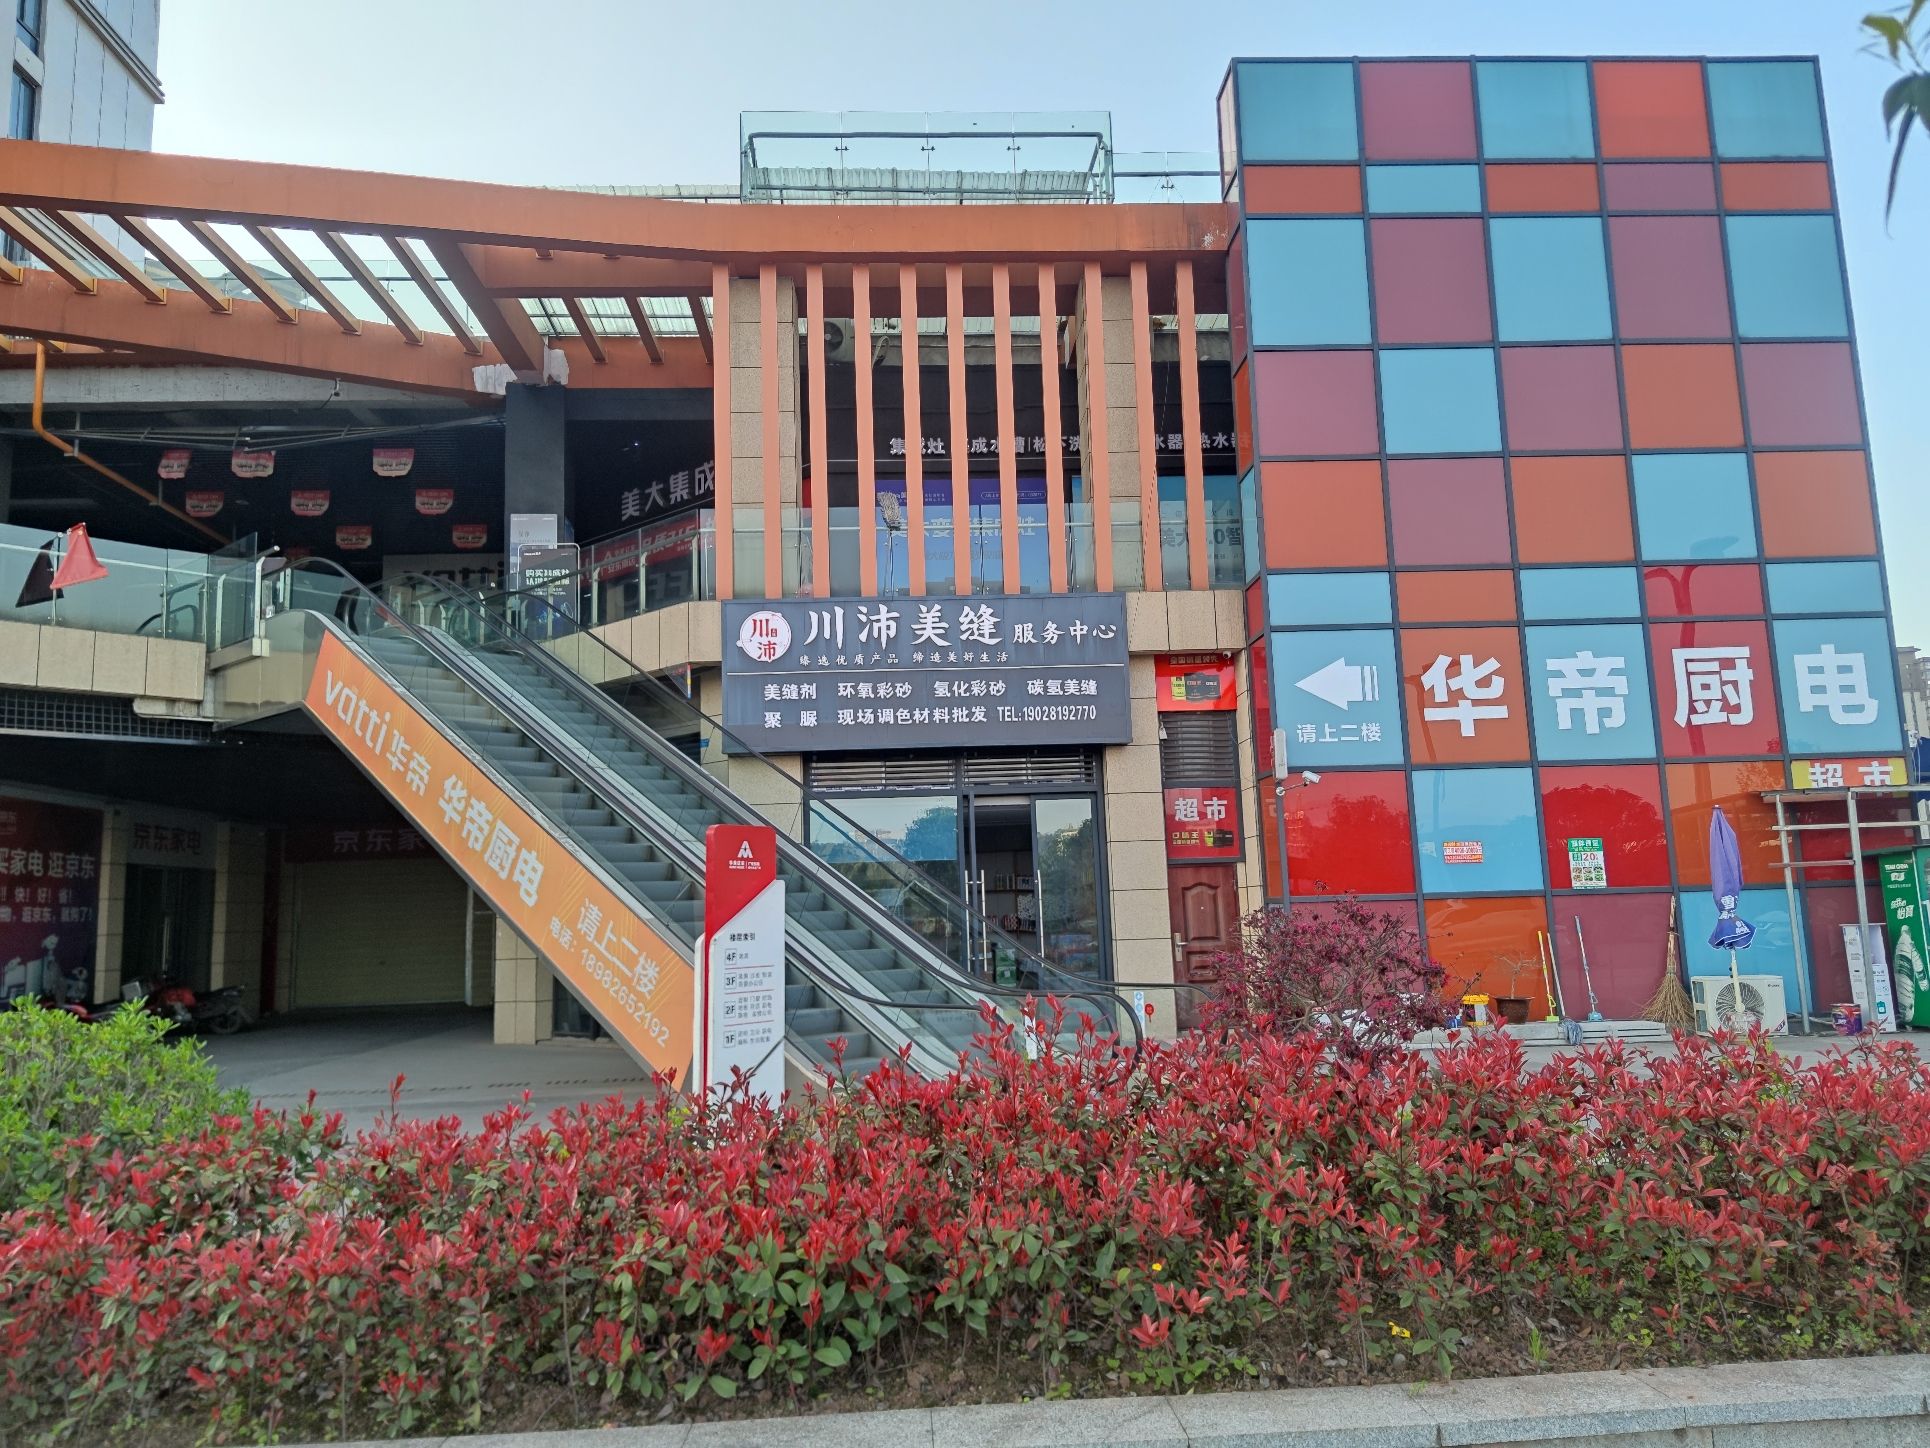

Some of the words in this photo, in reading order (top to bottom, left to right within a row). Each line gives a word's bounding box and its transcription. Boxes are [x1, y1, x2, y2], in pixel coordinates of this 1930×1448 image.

[803, 603, 1004, 650] 川沛美缝
[1013, 619, 1117, 646] 服务中心
[912, 651, 1009, 664] 缔造美好生活
[764, 682, 817, 701] 美缝剂
[838, 681, 913, 699] 环氧彩砂
[933, 679, 1007, 698] 氢化彩砂
[1026, 678, 1098, 696] 碳氢美缝
[1421, 644, 1878, 737] 华帝厨电
[838, 705, 988, 726] 现场调色材料批发
[1295, 721, 1382, 745] 请上二楼
[386, 728, 432, 798] 华帝
[438, 773, 546, 908] 华帝厨电
[1175, 796, 1228, 822] 超市
[576, 896, 662, 1000] 请上二楼
[726, 952, 736, 961] 4F
[725, 976, 736, 986] 3F
[725, 1004, 735, 1015] 2F
